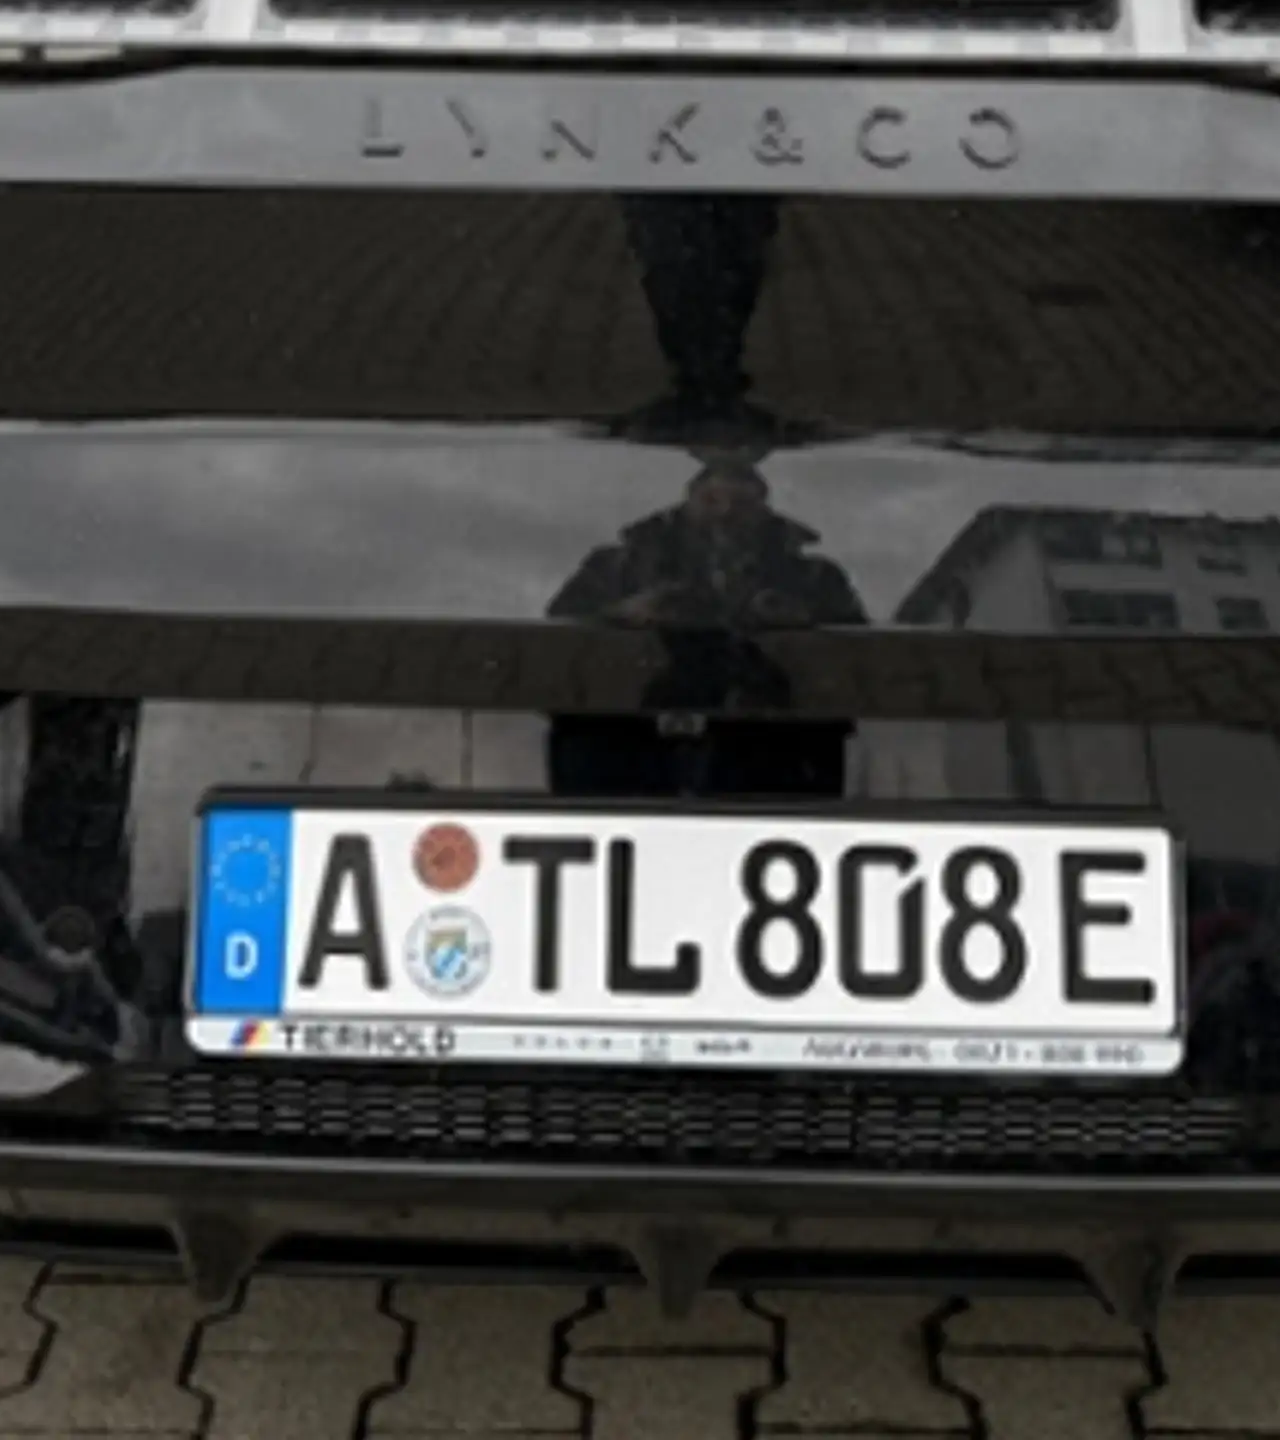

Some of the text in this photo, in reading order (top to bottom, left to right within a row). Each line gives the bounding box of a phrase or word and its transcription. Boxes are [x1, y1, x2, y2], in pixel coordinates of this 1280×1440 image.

[224, 931, 258, 980] D
[297, 834, 389, 991] A
[502, 836, 702, 996] TL
